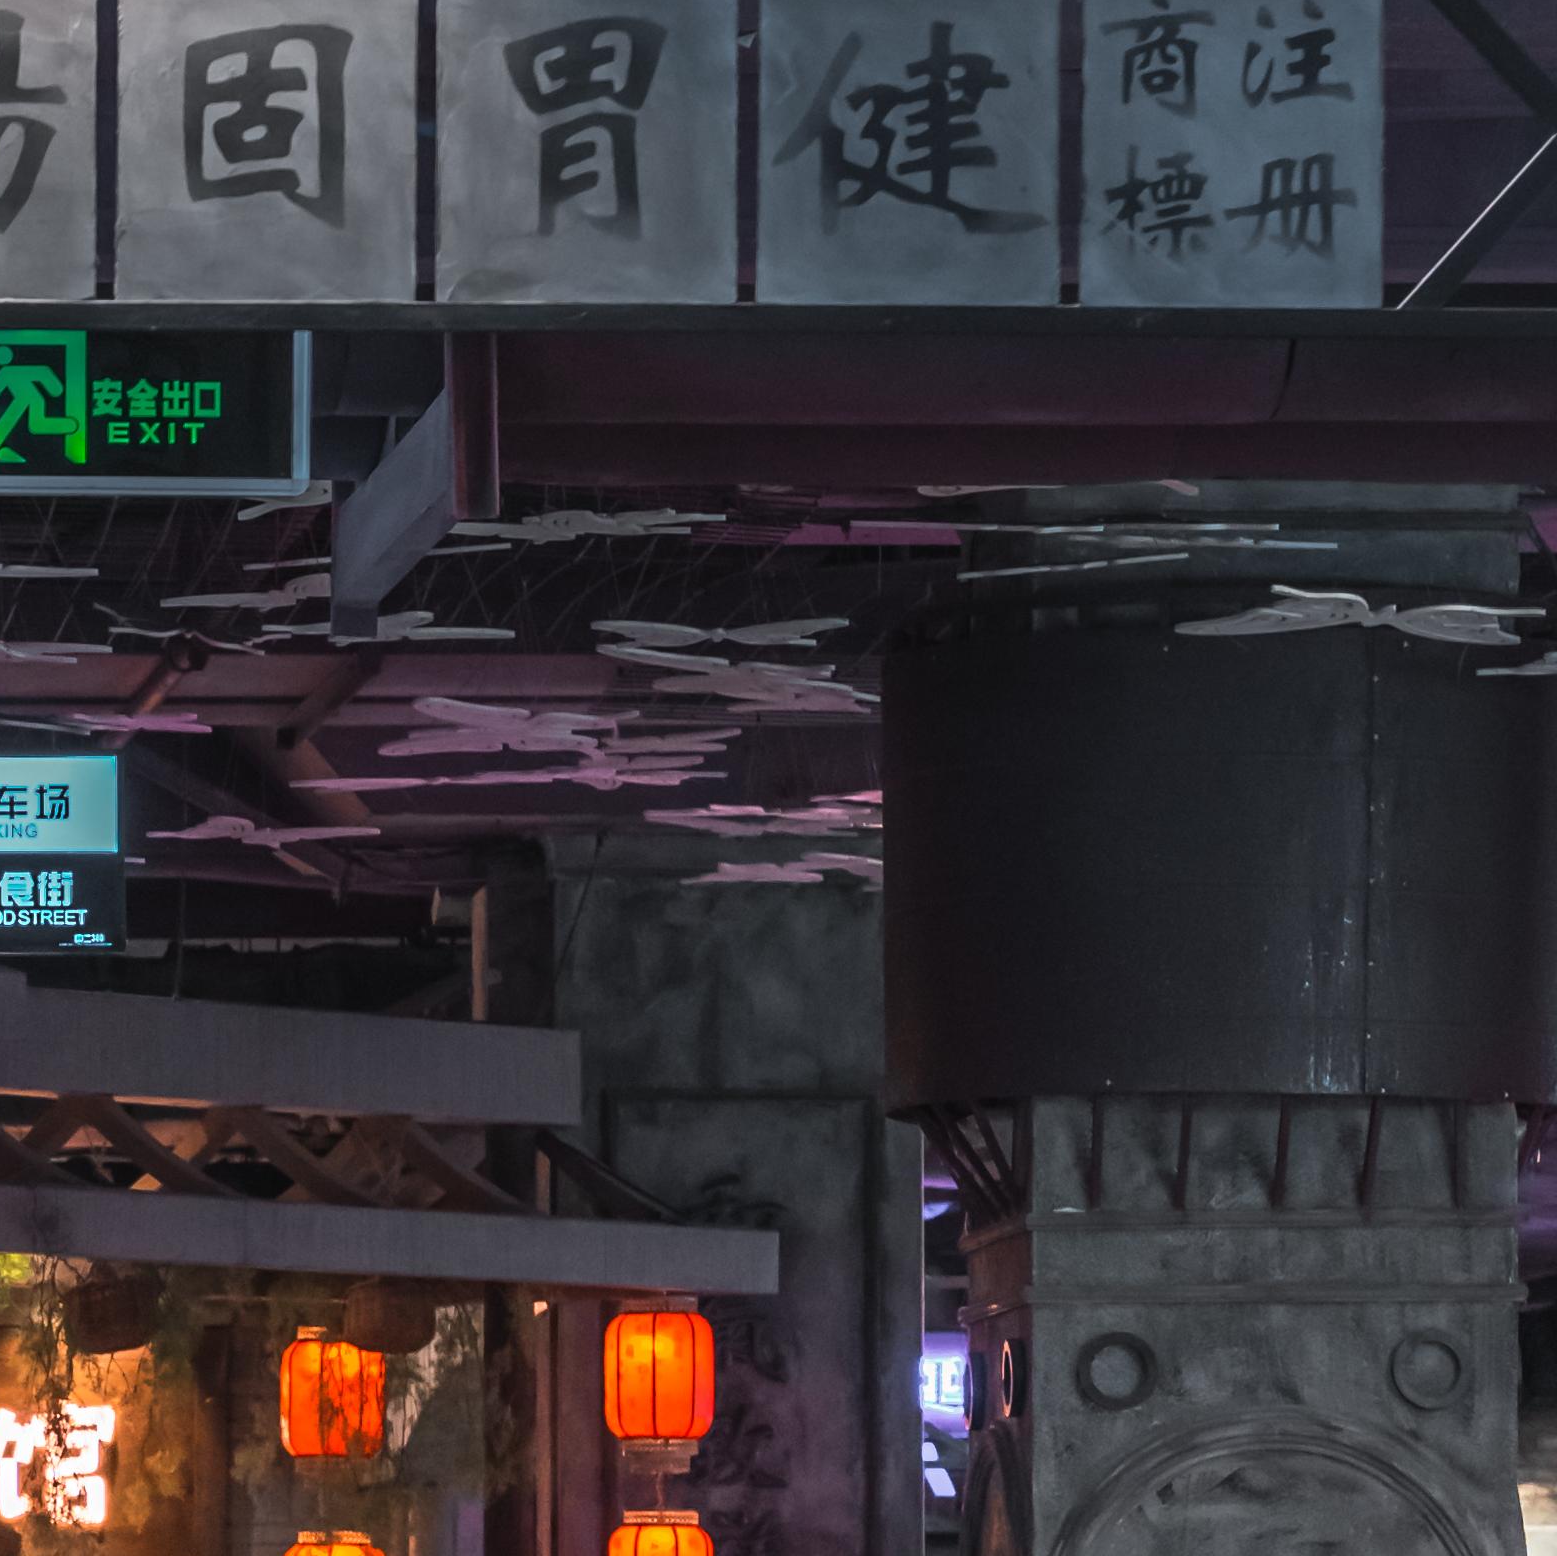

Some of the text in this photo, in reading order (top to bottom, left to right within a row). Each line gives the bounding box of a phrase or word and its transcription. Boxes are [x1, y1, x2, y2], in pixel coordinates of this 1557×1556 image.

[92, 377, 222, 418] 安全出口
[107, 422, 205, 444] EXIT
[18, 909, 88, 926] STREET
